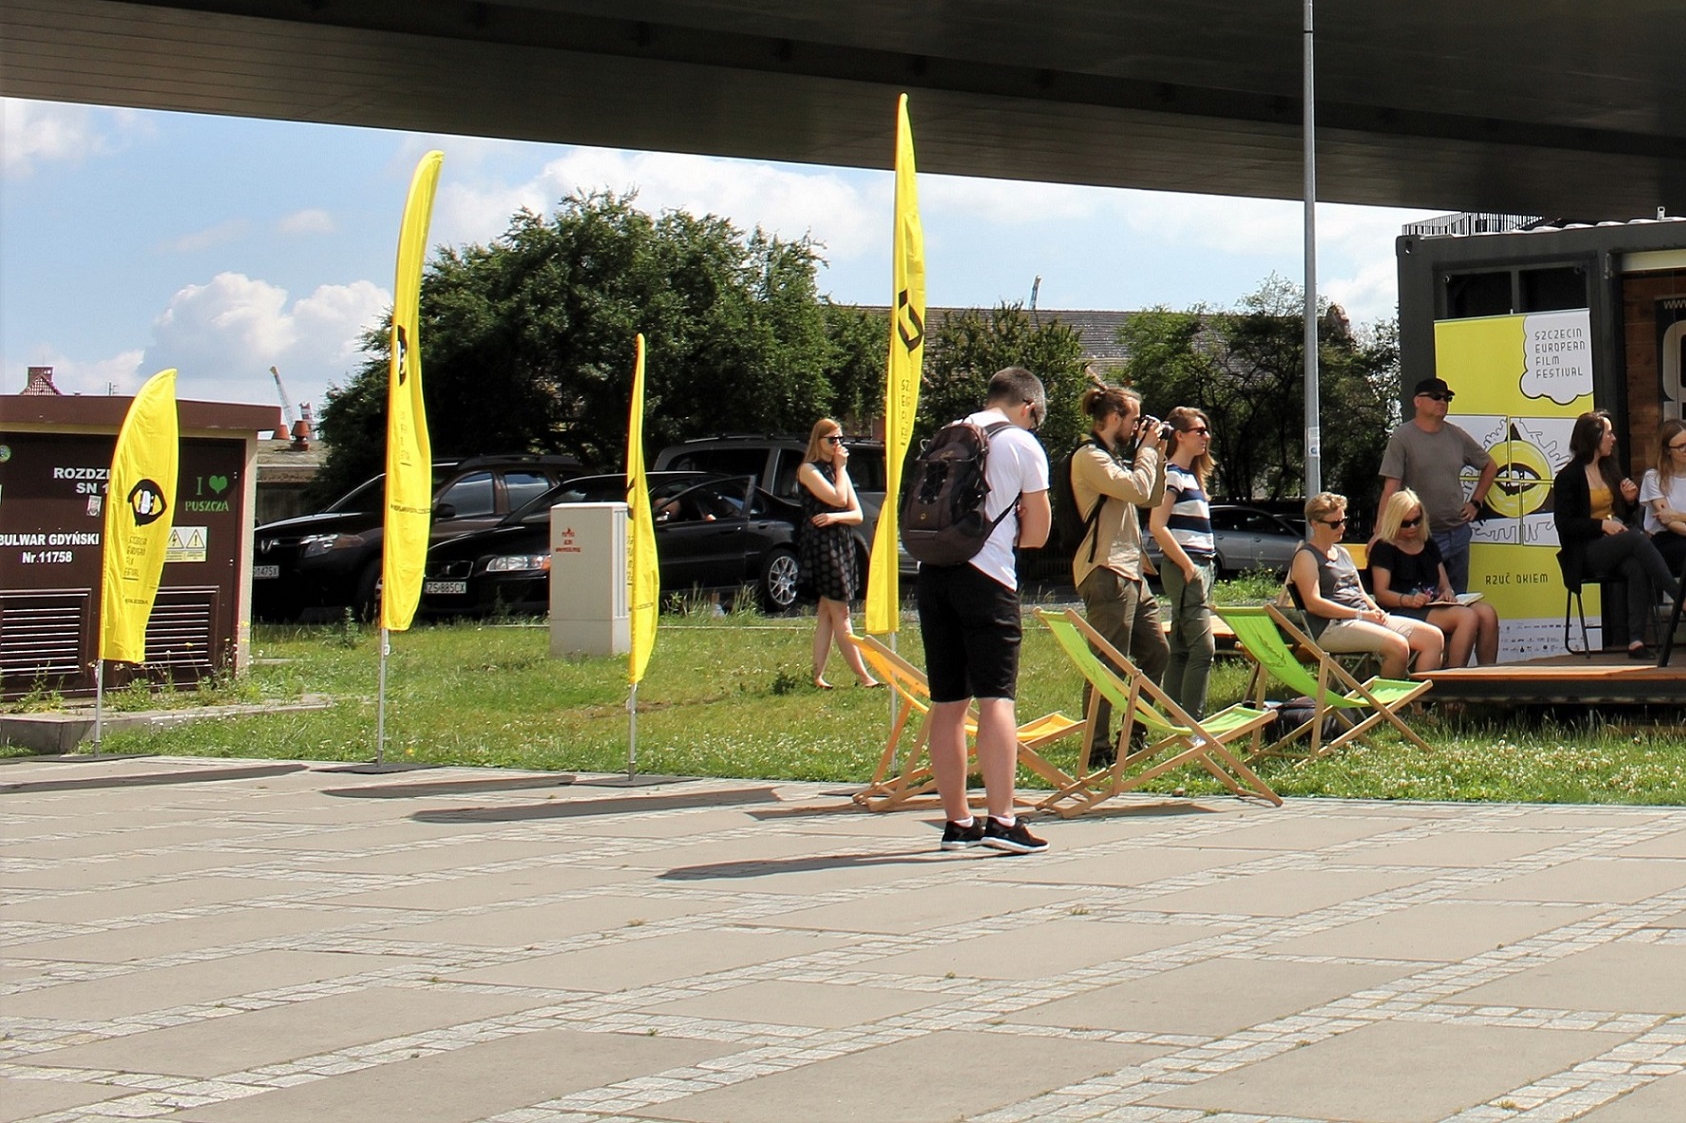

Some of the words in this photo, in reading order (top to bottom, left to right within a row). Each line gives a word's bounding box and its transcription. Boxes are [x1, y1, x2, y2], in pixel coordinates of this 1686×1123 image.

[1534, 327, 1582, 341] SZCZECIN
[1535, 340, 1586, 354] EUROPEAN
[1535, 355, 1560, 366] FILM
[1536, 366, 1583, 379] FESTIVAL
[76, 482, 97, 494] SN
[184, 500, 230, 512] PUSZCZA
[48, 530, 100, 545] GDYŃSKI
[1516, 573, 1549, 584] OKIEM
